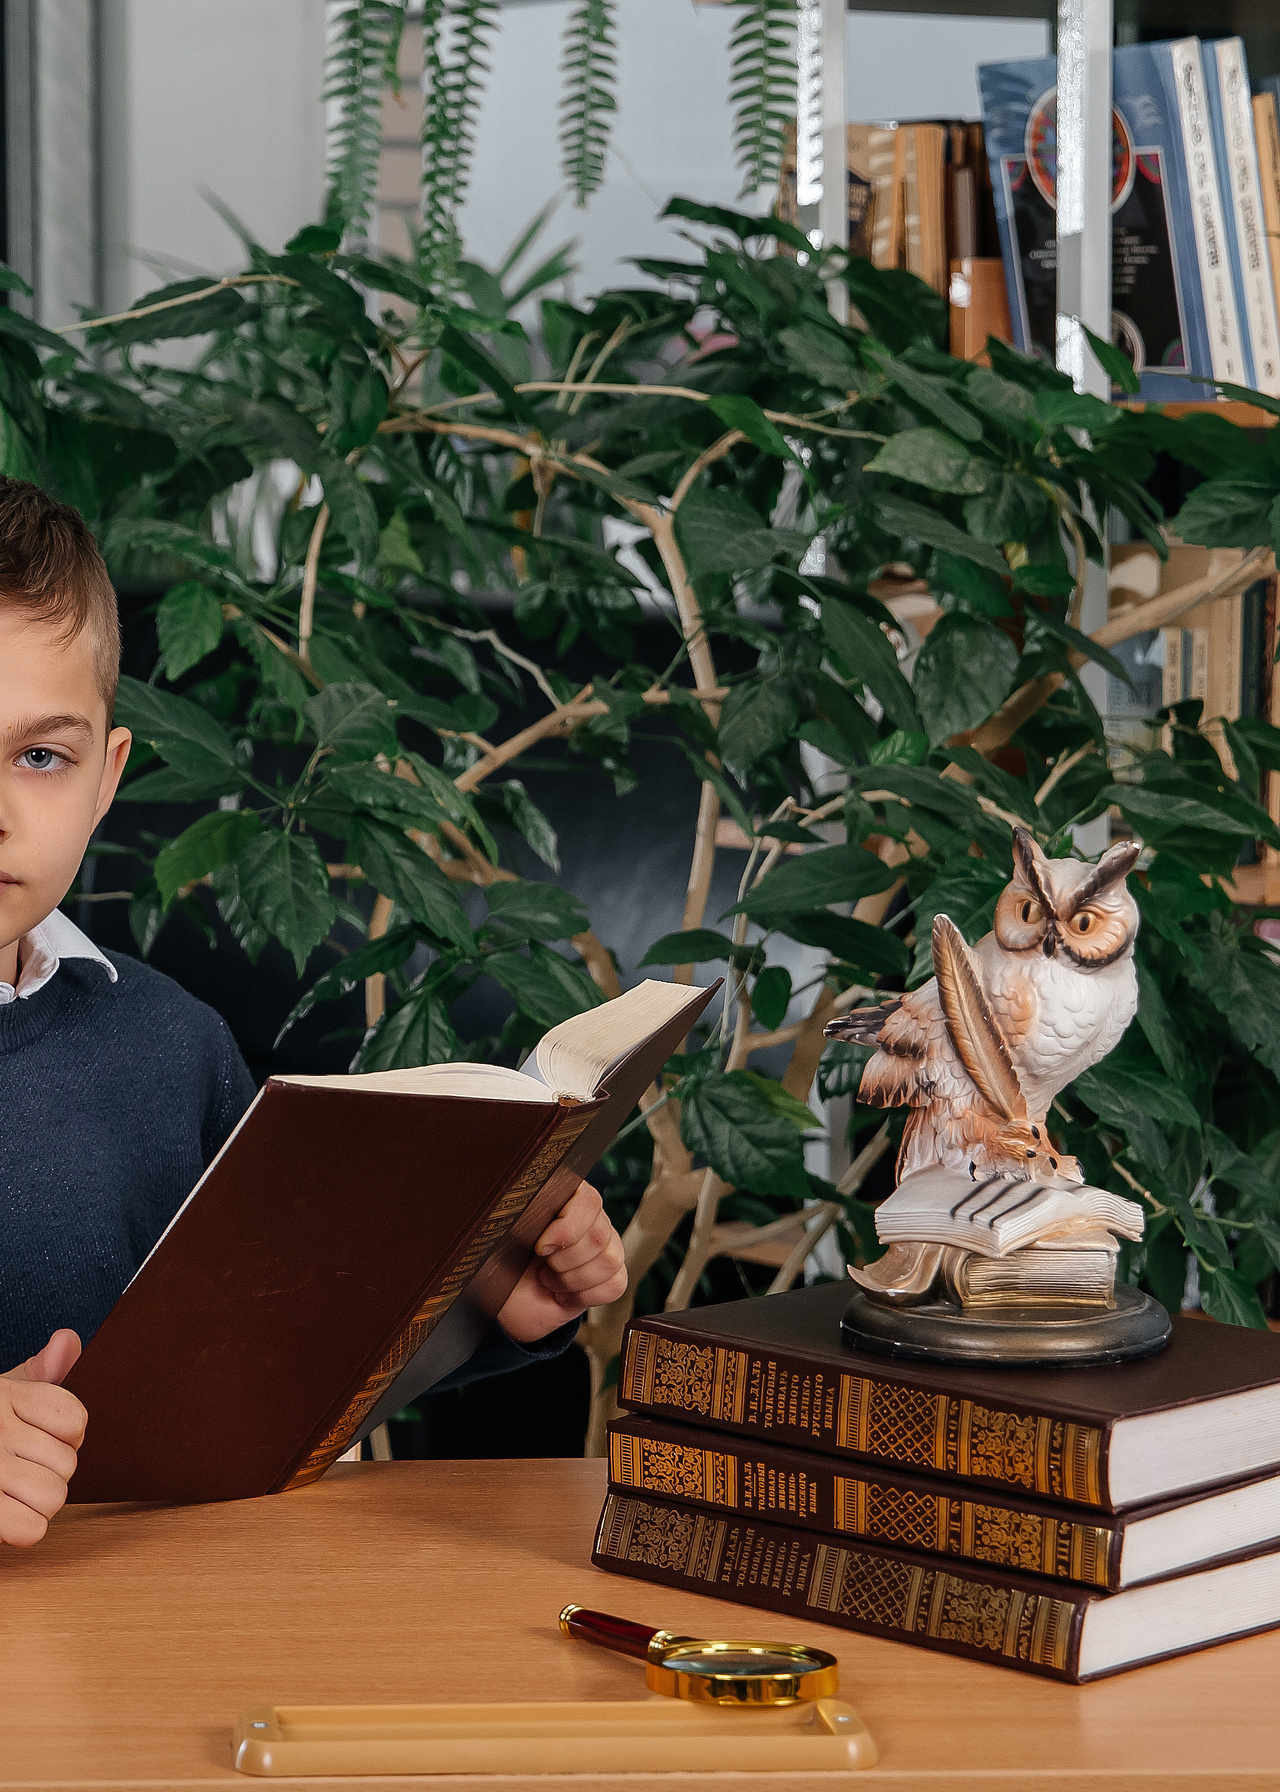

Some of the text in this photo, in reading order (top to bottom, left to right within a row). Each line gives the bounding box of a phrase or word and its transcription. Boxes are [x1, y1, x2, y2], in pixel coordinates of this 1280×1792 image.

[764, 1361, 777, 1428] ТОЛКОВЫЙ
[777, 1370, 788, 1424] СЛОВАРЬ
[788, 1374, 799, 1426] ЖИВОГО
[812, 1374, 823, 1437] РУССКОГО
[824, 1387, 835, 1429] ЯЗЫКА
[757, 1462, 766, 1511] ТОЛКОВЫЙ
[778, 1472, 786, 1510] ЖИВОГО
[809, 1482, 817, 1514] ЯЗЫКА
[736, 1528, 755, 1586] ТОЛКОВЫЙ
[748, 1537, 765, 1584] СЛОВАРЬ
[760, 1541, 775, 1586] ЖИВОГО
[782, 1541, 800, 1596] РУССКОГО
[796, 1553, 811, 1591] ЯЗЫКА
